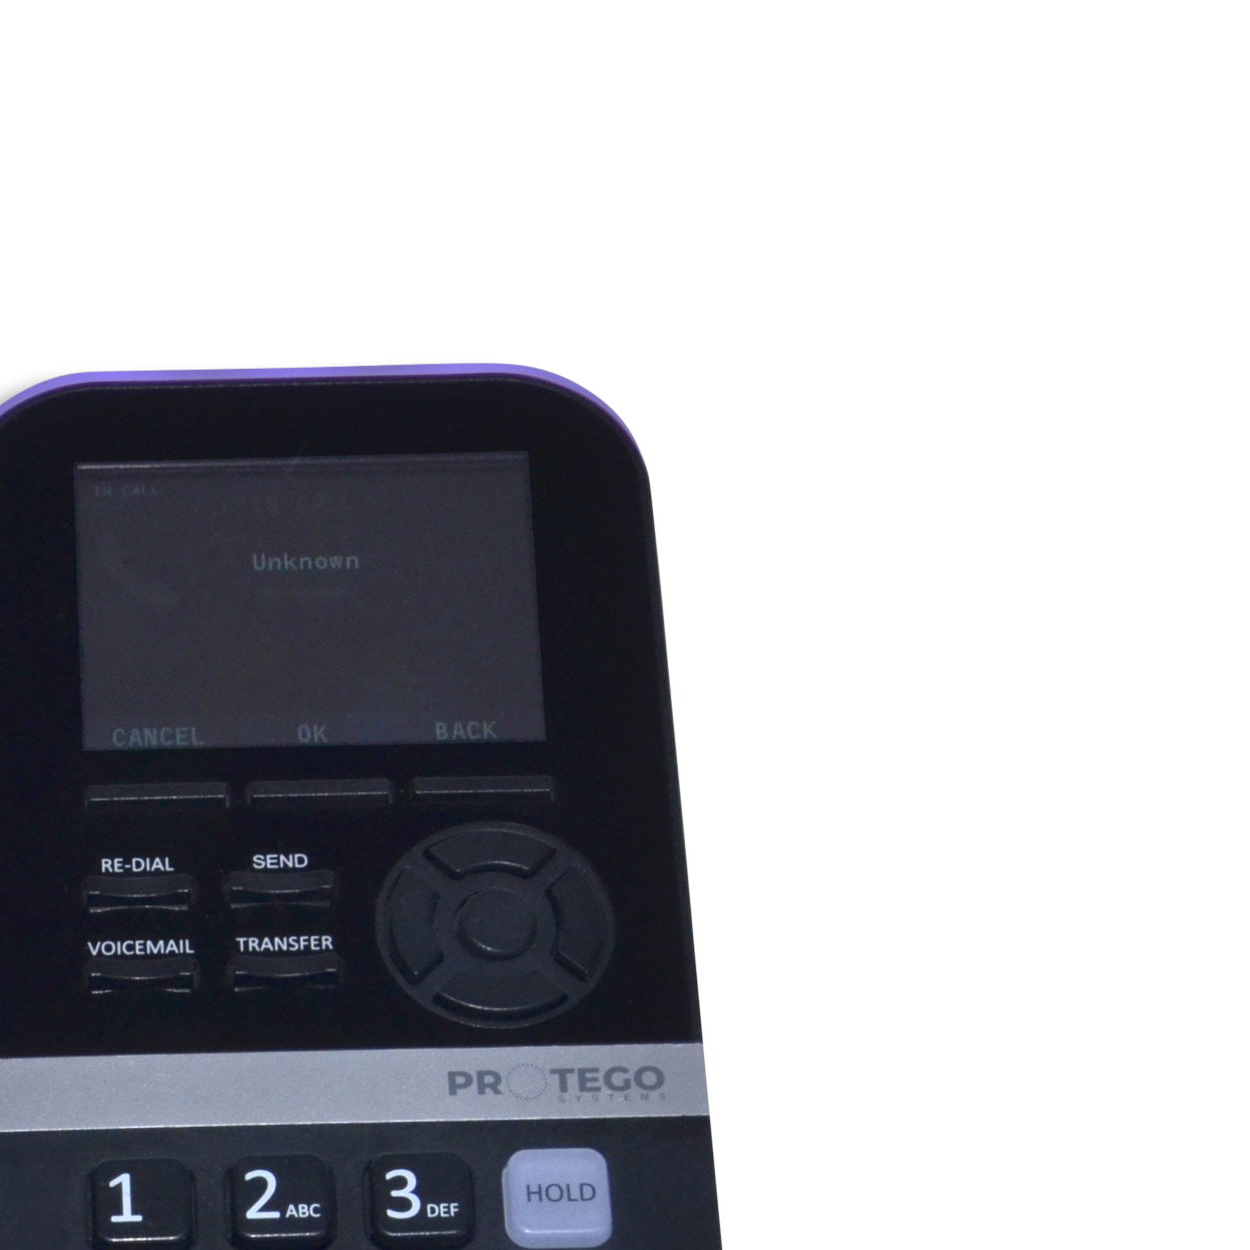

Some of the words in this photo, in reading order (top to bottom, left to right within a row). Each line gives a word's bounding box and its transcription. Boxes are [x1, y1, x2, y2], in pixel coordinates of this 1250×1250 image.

[253, 553, 359, 570] Unknown
[112, 727, 204, 746] CANCEL
[298, 724, 327, 742] OK
[435, 721, 496, 740] BACK
[102, 857, 173, 872] RE-DIAL
[253, 854, 308, 869] SEND
[88, 940, 194, 955] VOICEMAIL
[236, 936, 333, 951] TRANSFER
[559, 1092, 667, 1104] SYSTEMS
[109, 1173, 142, 1222] 1
[245, 1170, 280, 1219] 2
[286, 1204, 320, 1217] ABC
[386, 1169, 421, 1219] 3
[427, 1203, 458, 1217] DEF
[526, 1183, 596, 1202] HOLD
